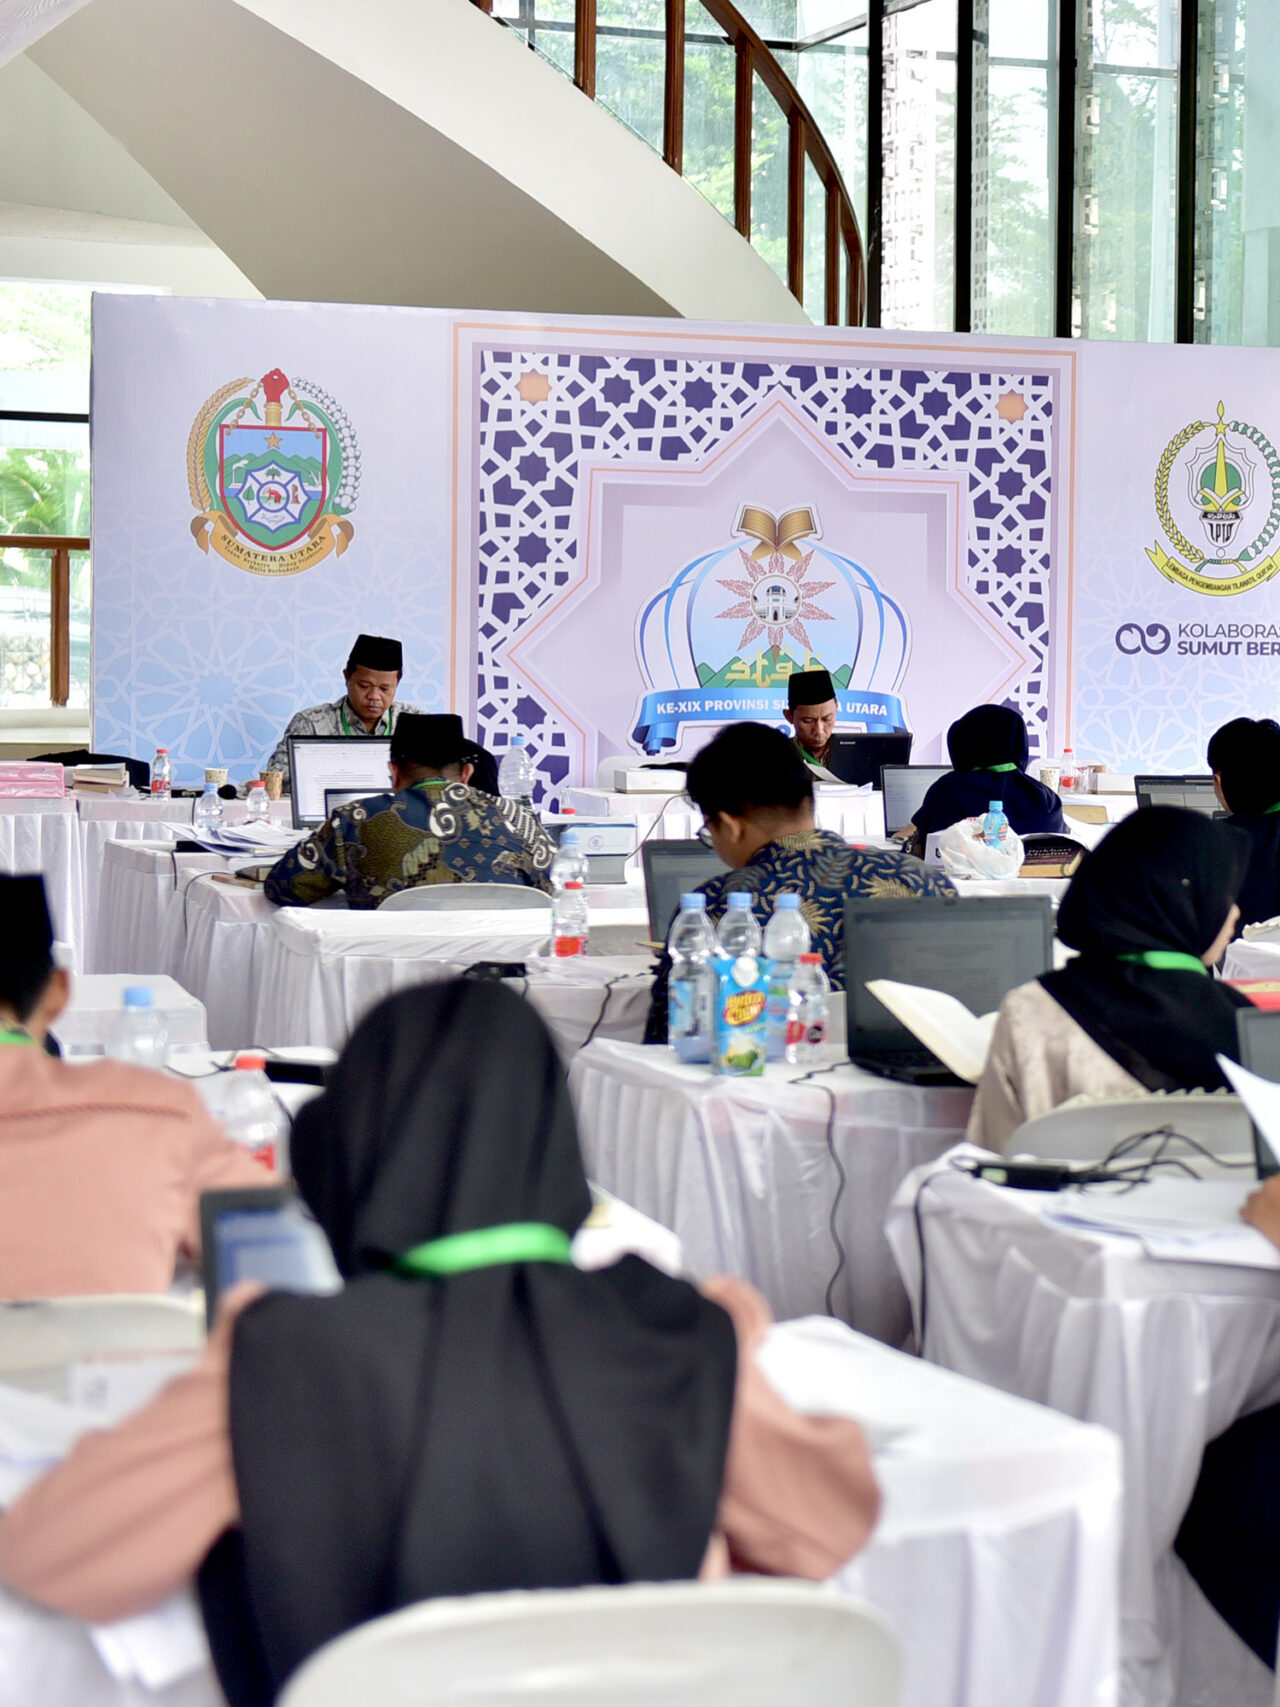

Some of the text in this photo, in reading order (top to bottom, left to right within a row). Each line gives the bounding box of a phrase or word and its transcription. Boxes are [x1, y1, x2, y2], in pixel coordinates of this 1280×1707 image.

[220, 534, 326, 562] SUMATERA UTARA
[1166, 561, 1189, 582] LEMBAGA
[1189, 576, 1232, 592] PENGEMBANGAN
[1177, 640, 1242, 656] SUMUT
[656, 700, 702, 715] KE-XIX
[704, 698, 769, 712] PROVINSI
[846, 701, 888, 716] UTARA
